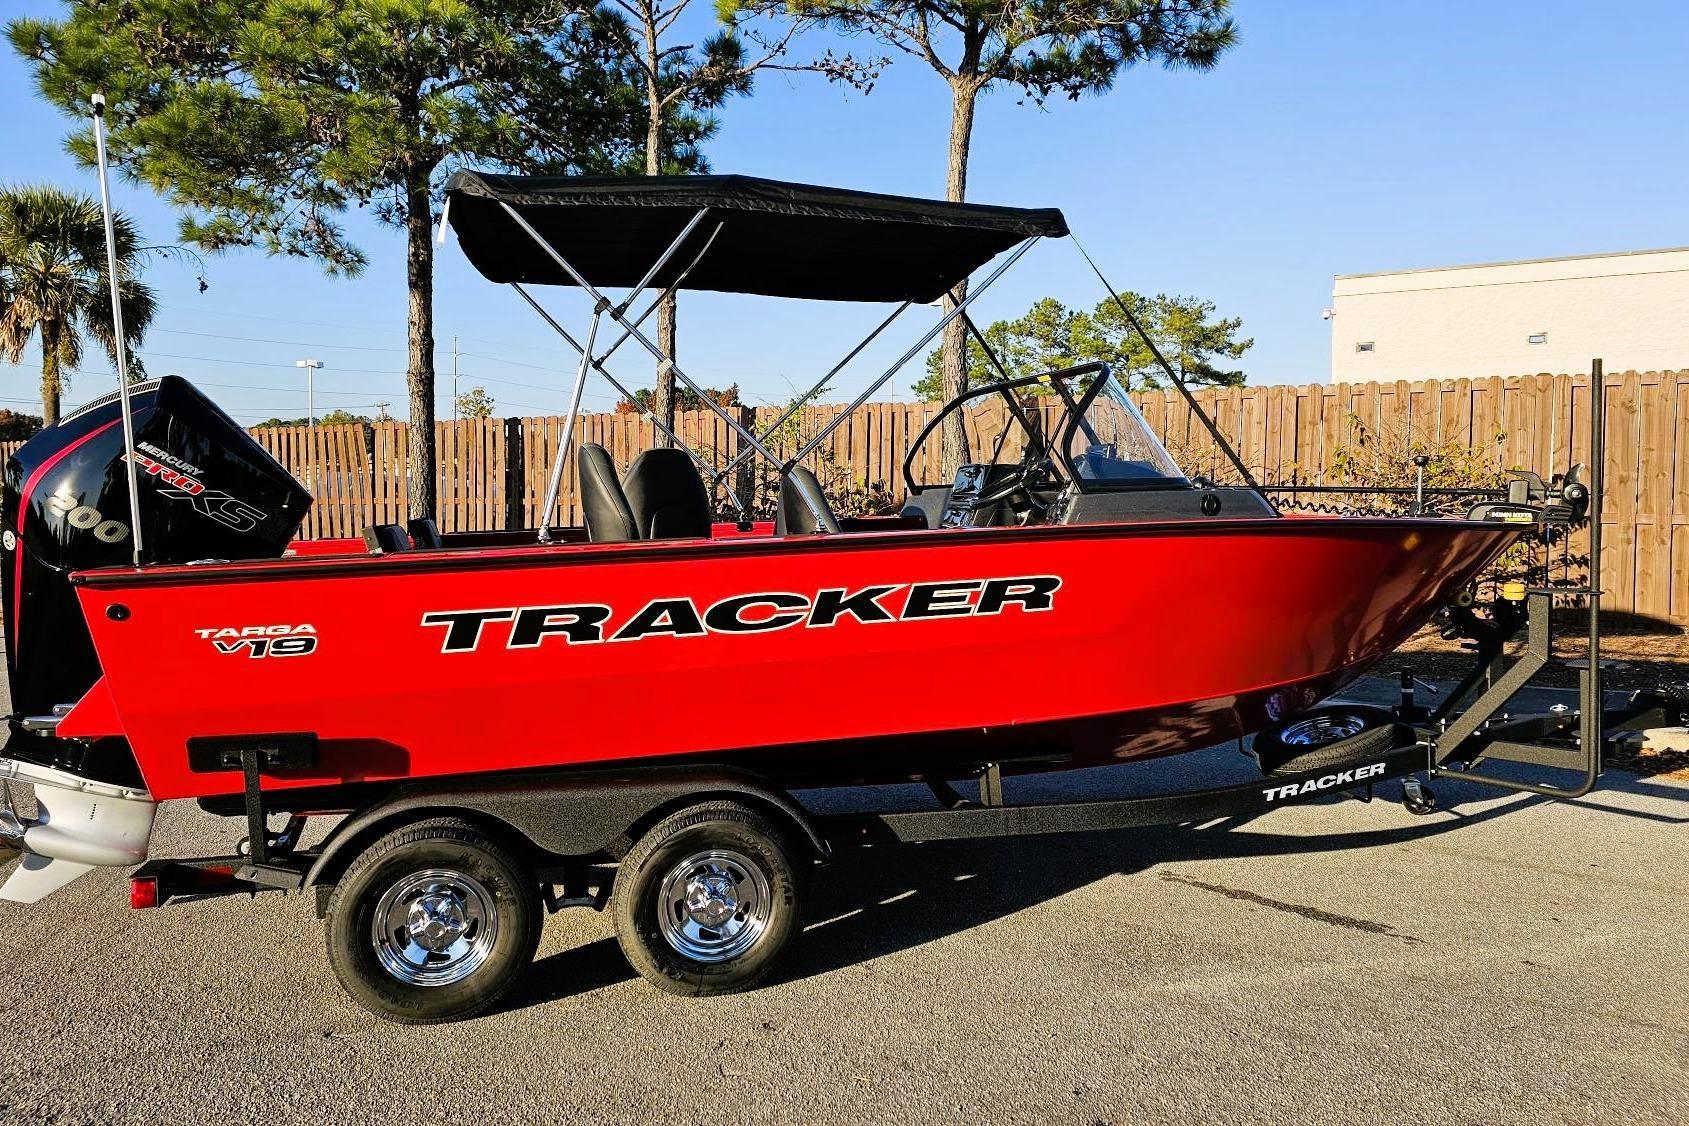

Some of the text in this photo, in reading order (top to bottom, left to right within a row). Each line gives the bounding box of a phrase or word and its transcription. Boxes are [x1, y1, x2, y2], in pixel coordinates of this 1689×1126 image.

[120, 451, 205, 496] PRO
[137, 441, 205, 476] MERCURY
[156, 489, 268, 533] XS
[194, 623, 317, 639] TARGA
[421, 574, 1063, 654] TRACKER
[211, 635, 318, 659] V19
[1262, 762, 1387, 802] TRACKER
